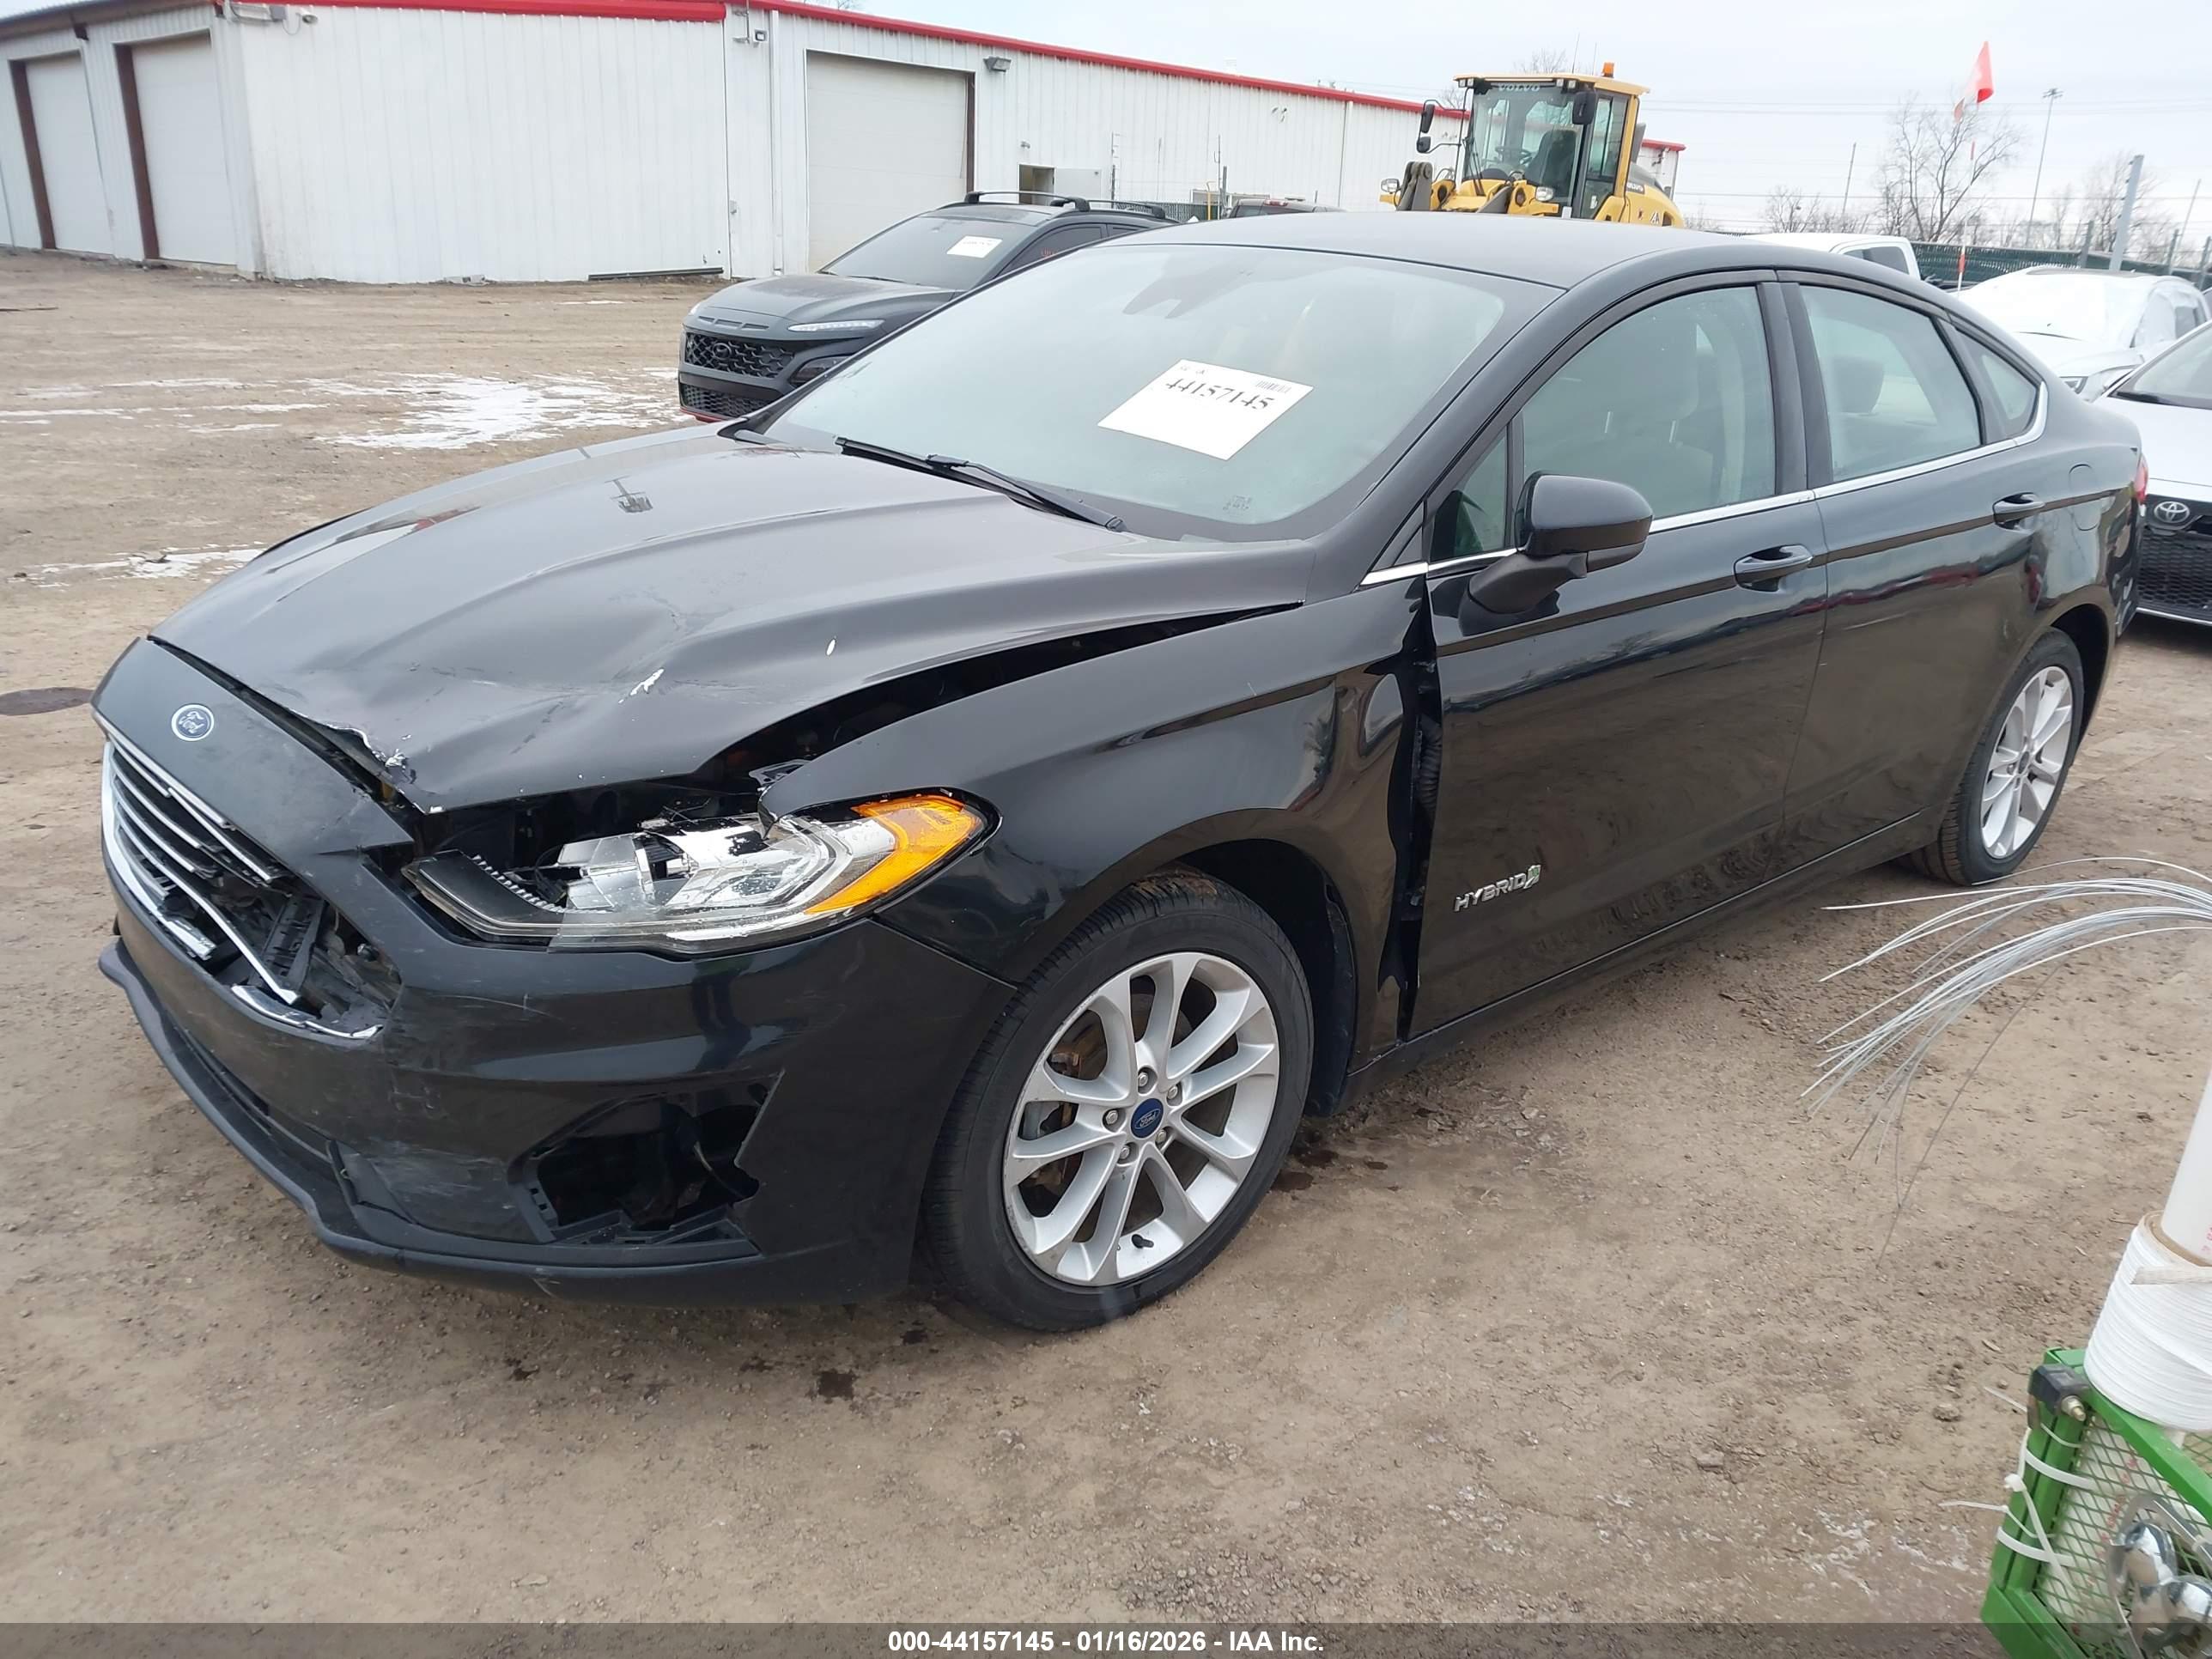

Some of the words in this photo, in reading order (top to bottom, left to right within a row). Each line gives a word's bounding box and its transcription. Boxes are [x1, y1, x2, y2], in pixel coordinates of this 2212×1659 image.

[1498, 82, 1540, 92] VOLVO
[1165, 378, 1276, 410] 44157145
[1453, 872, 1527, 912] HYBRID
[1139, 1111, 1157, 1128] Ford
